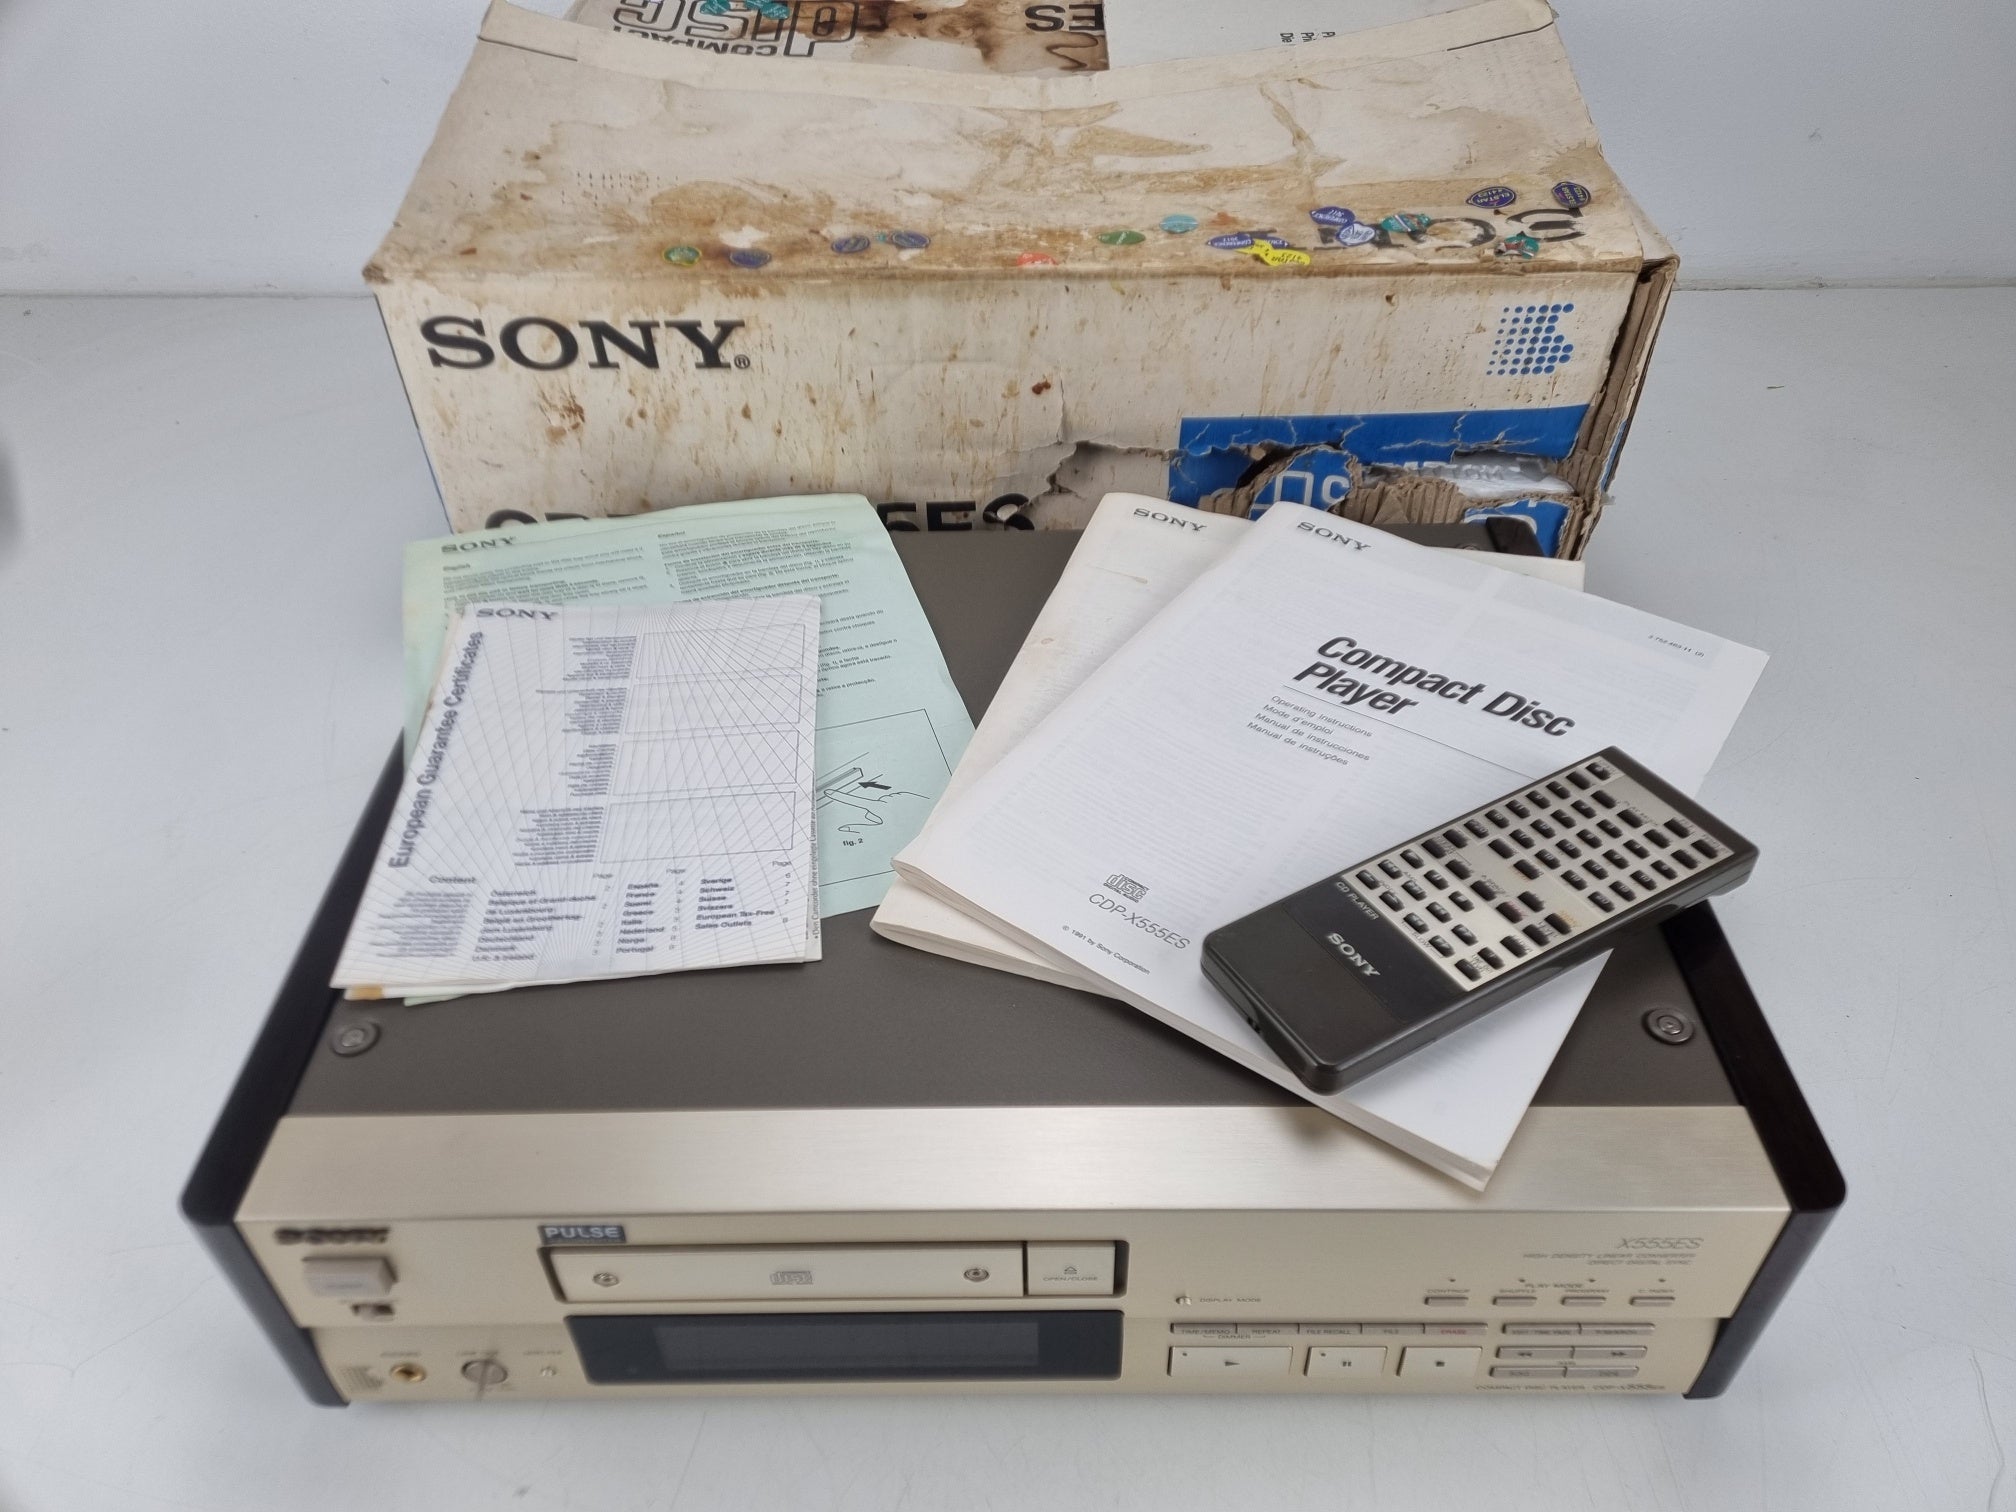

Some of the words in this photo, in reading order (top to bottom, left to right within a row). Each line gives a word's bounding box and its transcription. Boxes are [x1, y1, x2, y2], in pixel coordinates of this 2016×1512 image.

[612, 25, 778, 57] COMP
[1475, 191, 1511, 205] ELSTAR
[419, 315, 746, 370] SONY
[1133, 507, 1207, 532] SONY
[441, 536, 516, 553] SONY
[1297, 520, 1372, 552] SONY
[476, 608, 558, 621] SONY
[1292, 661, 1419, 715] Player
[1317, 636, 1487, 704] Compact
[1482, 690, 1576, 737] Disc
[1263, 704, 1290, 720] Mode
[1292, 713, 1334, 736] d'emploi
[1271, 695, 1317, 718] Operating
[1319, 712, 1373, 738] Instructions
[388, 788, 432, 868] European
[417, 709, 458, 787] Guarantee
[444, 631, 484, 708] Certificates
[1247, 721, 1283, 742] Manual
[1298, 741, 1349, 766] instruções
[1254, 712, 1295, 731] Manual
[1306, 730, 1371, 761] instrucciones
[1104, 873, 1148, 901] disc
[1336, 881, 1351, 893] CD
[1348, 892, 1380, 920] PLAYER
[695, 922, 719, 930] Sales
[720, 920, 752, 929] Outlets
[696, 912, 737, 921] European
[1088, 893, 1191, 949] CDP-X555ES
[1096, 943, 1113, 955] Sony
[1113, 952, 1151, 975] Corporation
[1327, 932, 1381, 977] SONY
[544, 1225, 621, 1240] PULSE
[1616, 1236, 1705, 1250] X555ES
[1041, 1275, 1099, 1283] OPEN/CLOSE
